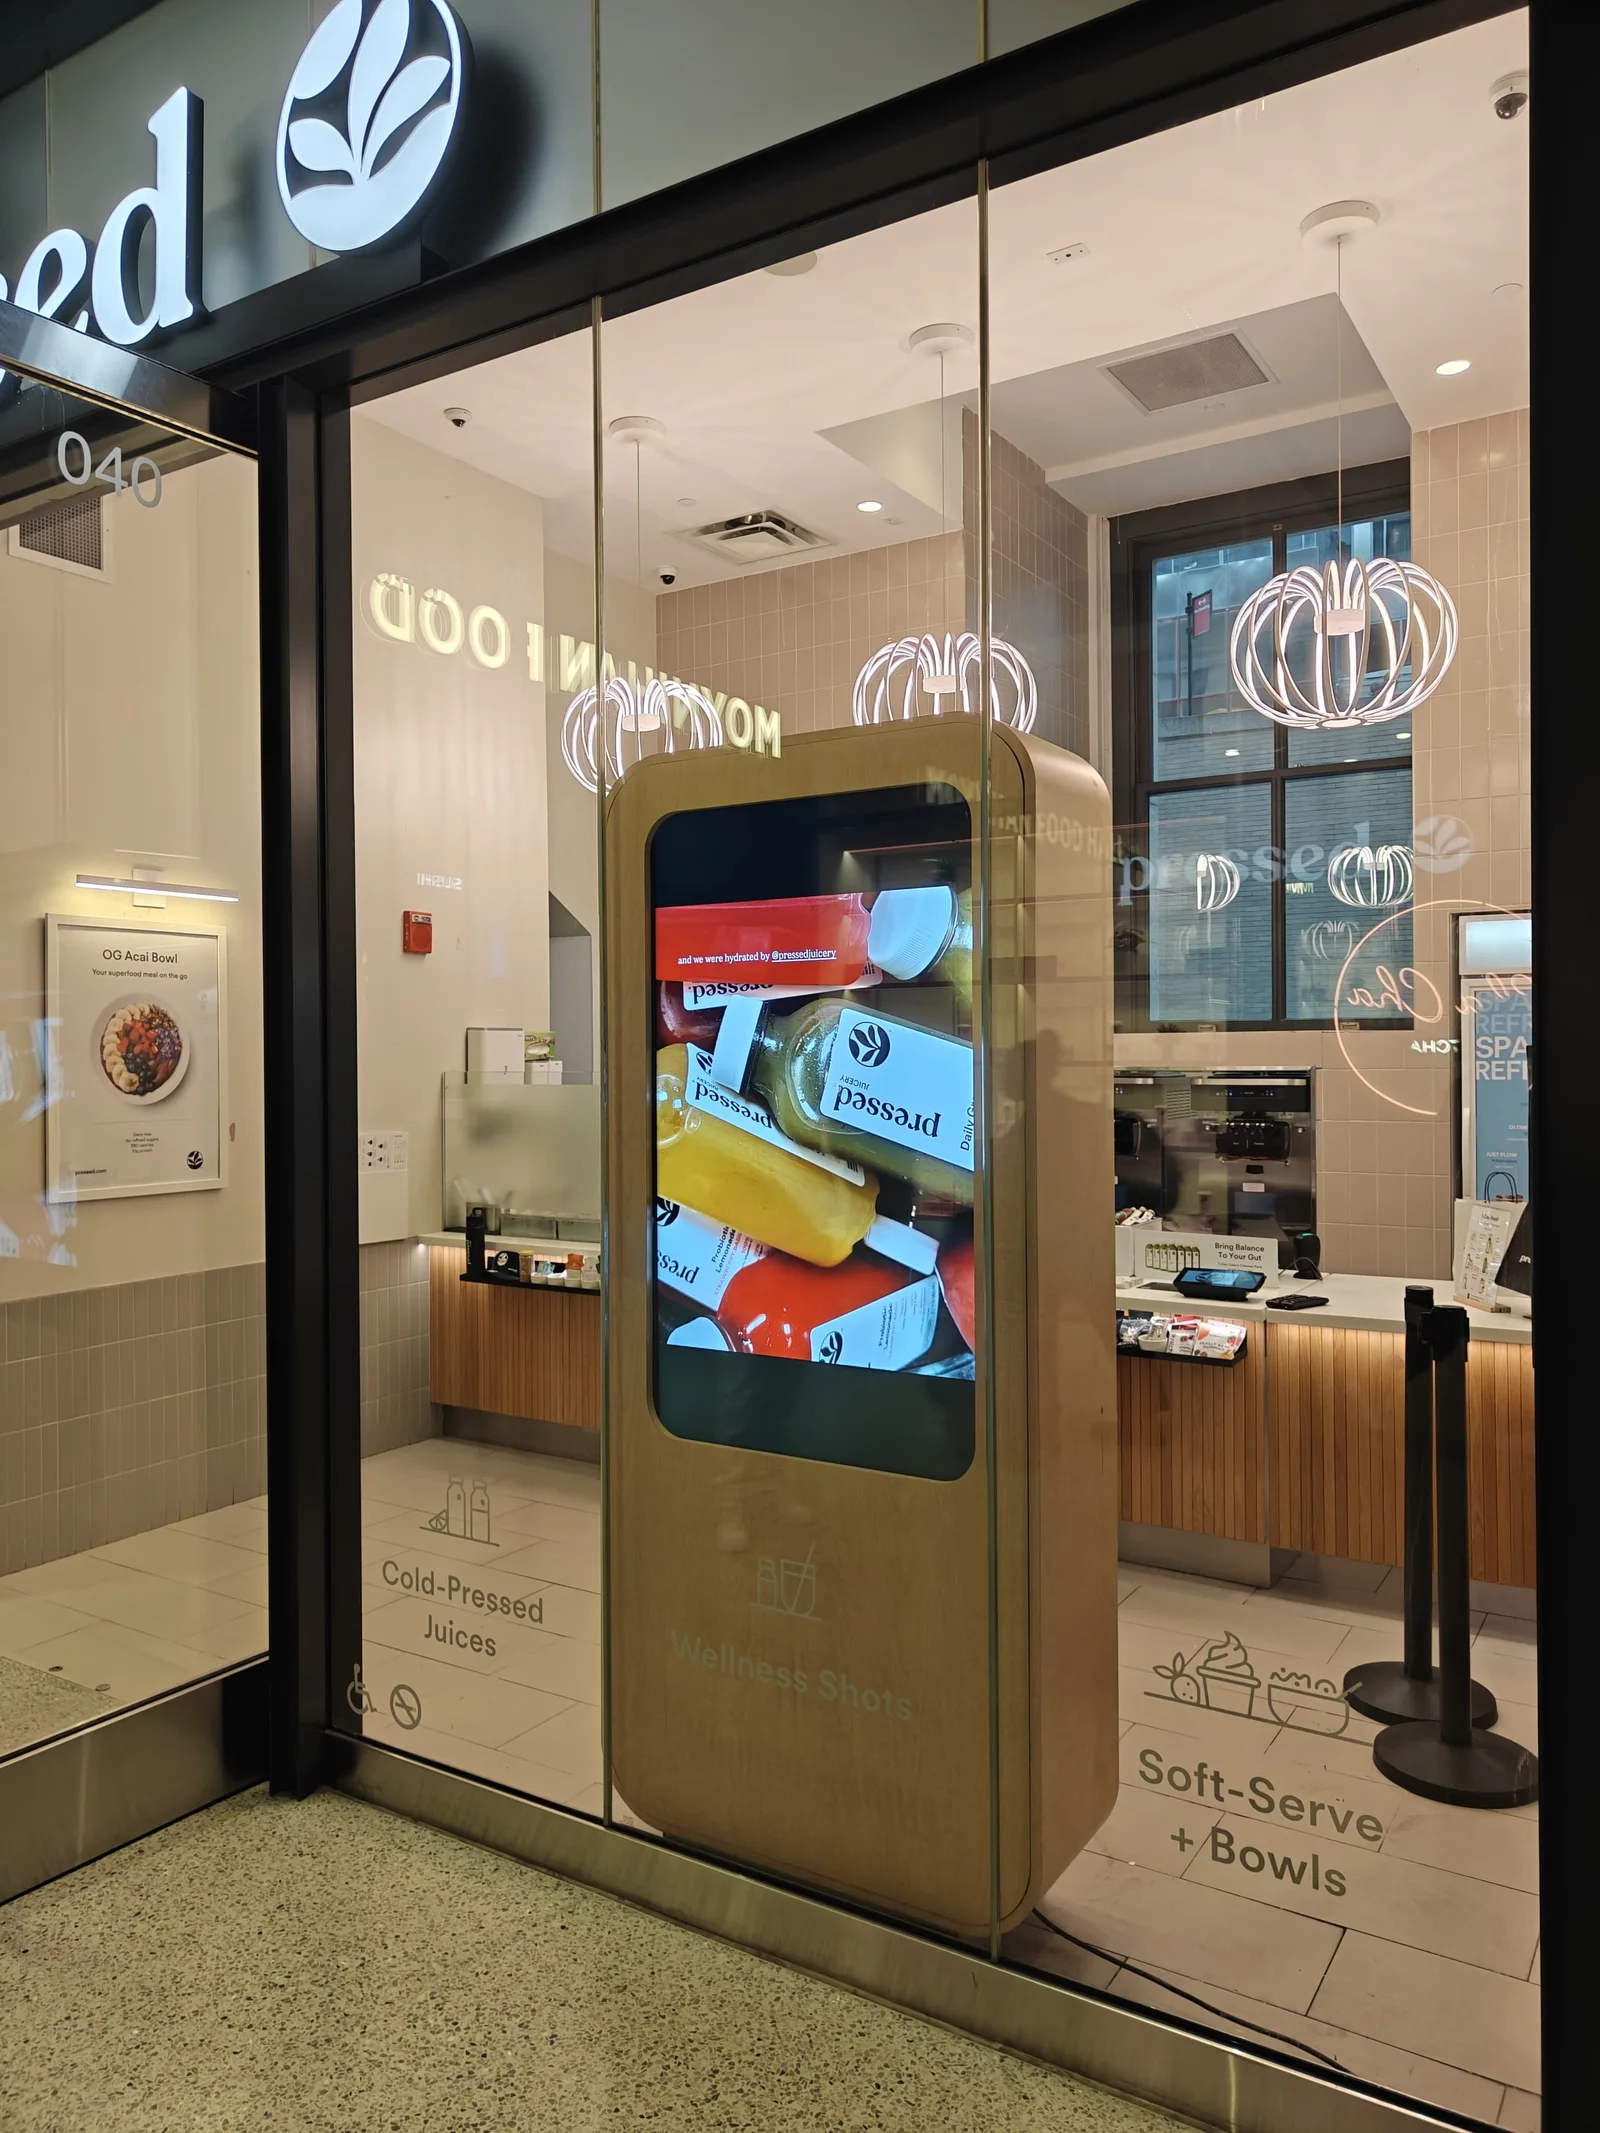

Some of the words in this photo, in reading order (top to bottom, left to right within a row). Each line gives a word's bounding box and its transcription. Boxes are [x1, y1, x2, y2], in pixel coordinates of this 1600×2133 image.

[0, 86, 194, 347] ed
[57, 431, 162, 508] 040
[92, 968, 107, 976] Your
[102, 949, 122, 961] OG
[124, 950, 149, 962] Acai
[151, 952, 178, 963] Bowl
[678, 954, 692, 965] and
[705, 954, 723, 963] were
[724, 951, 759, 964] hydrated
[760, 952, 770, 962] by
[771, 949, 837, 962] @pressedjuicery
[695, 1081, 772, 1129] pressed
[839, 1074, 870, 1091] JUICERY
[833, 1085, 942, 1138] pressed
[960, 1119, 975, 1151] Daily
[1214, 1242, 1234, 1251] Bring
[1235, 1243, 1265, 1252] Balance
[1247, 1253, 1262, 1261] Gut
[382, 1560, 543, 1624] Cold-Pressed
[424, 1614, 496, 1656] Juices
[671, 1630, 808, 1693] Wellness
[818, 1669, 912, 1721] Shots
[1139, 1748, 1384, 1842] Soft-Serve
[1171, 1828, 1194, 1852] +
[1211, 1826, 1347, 1897] Bowls
